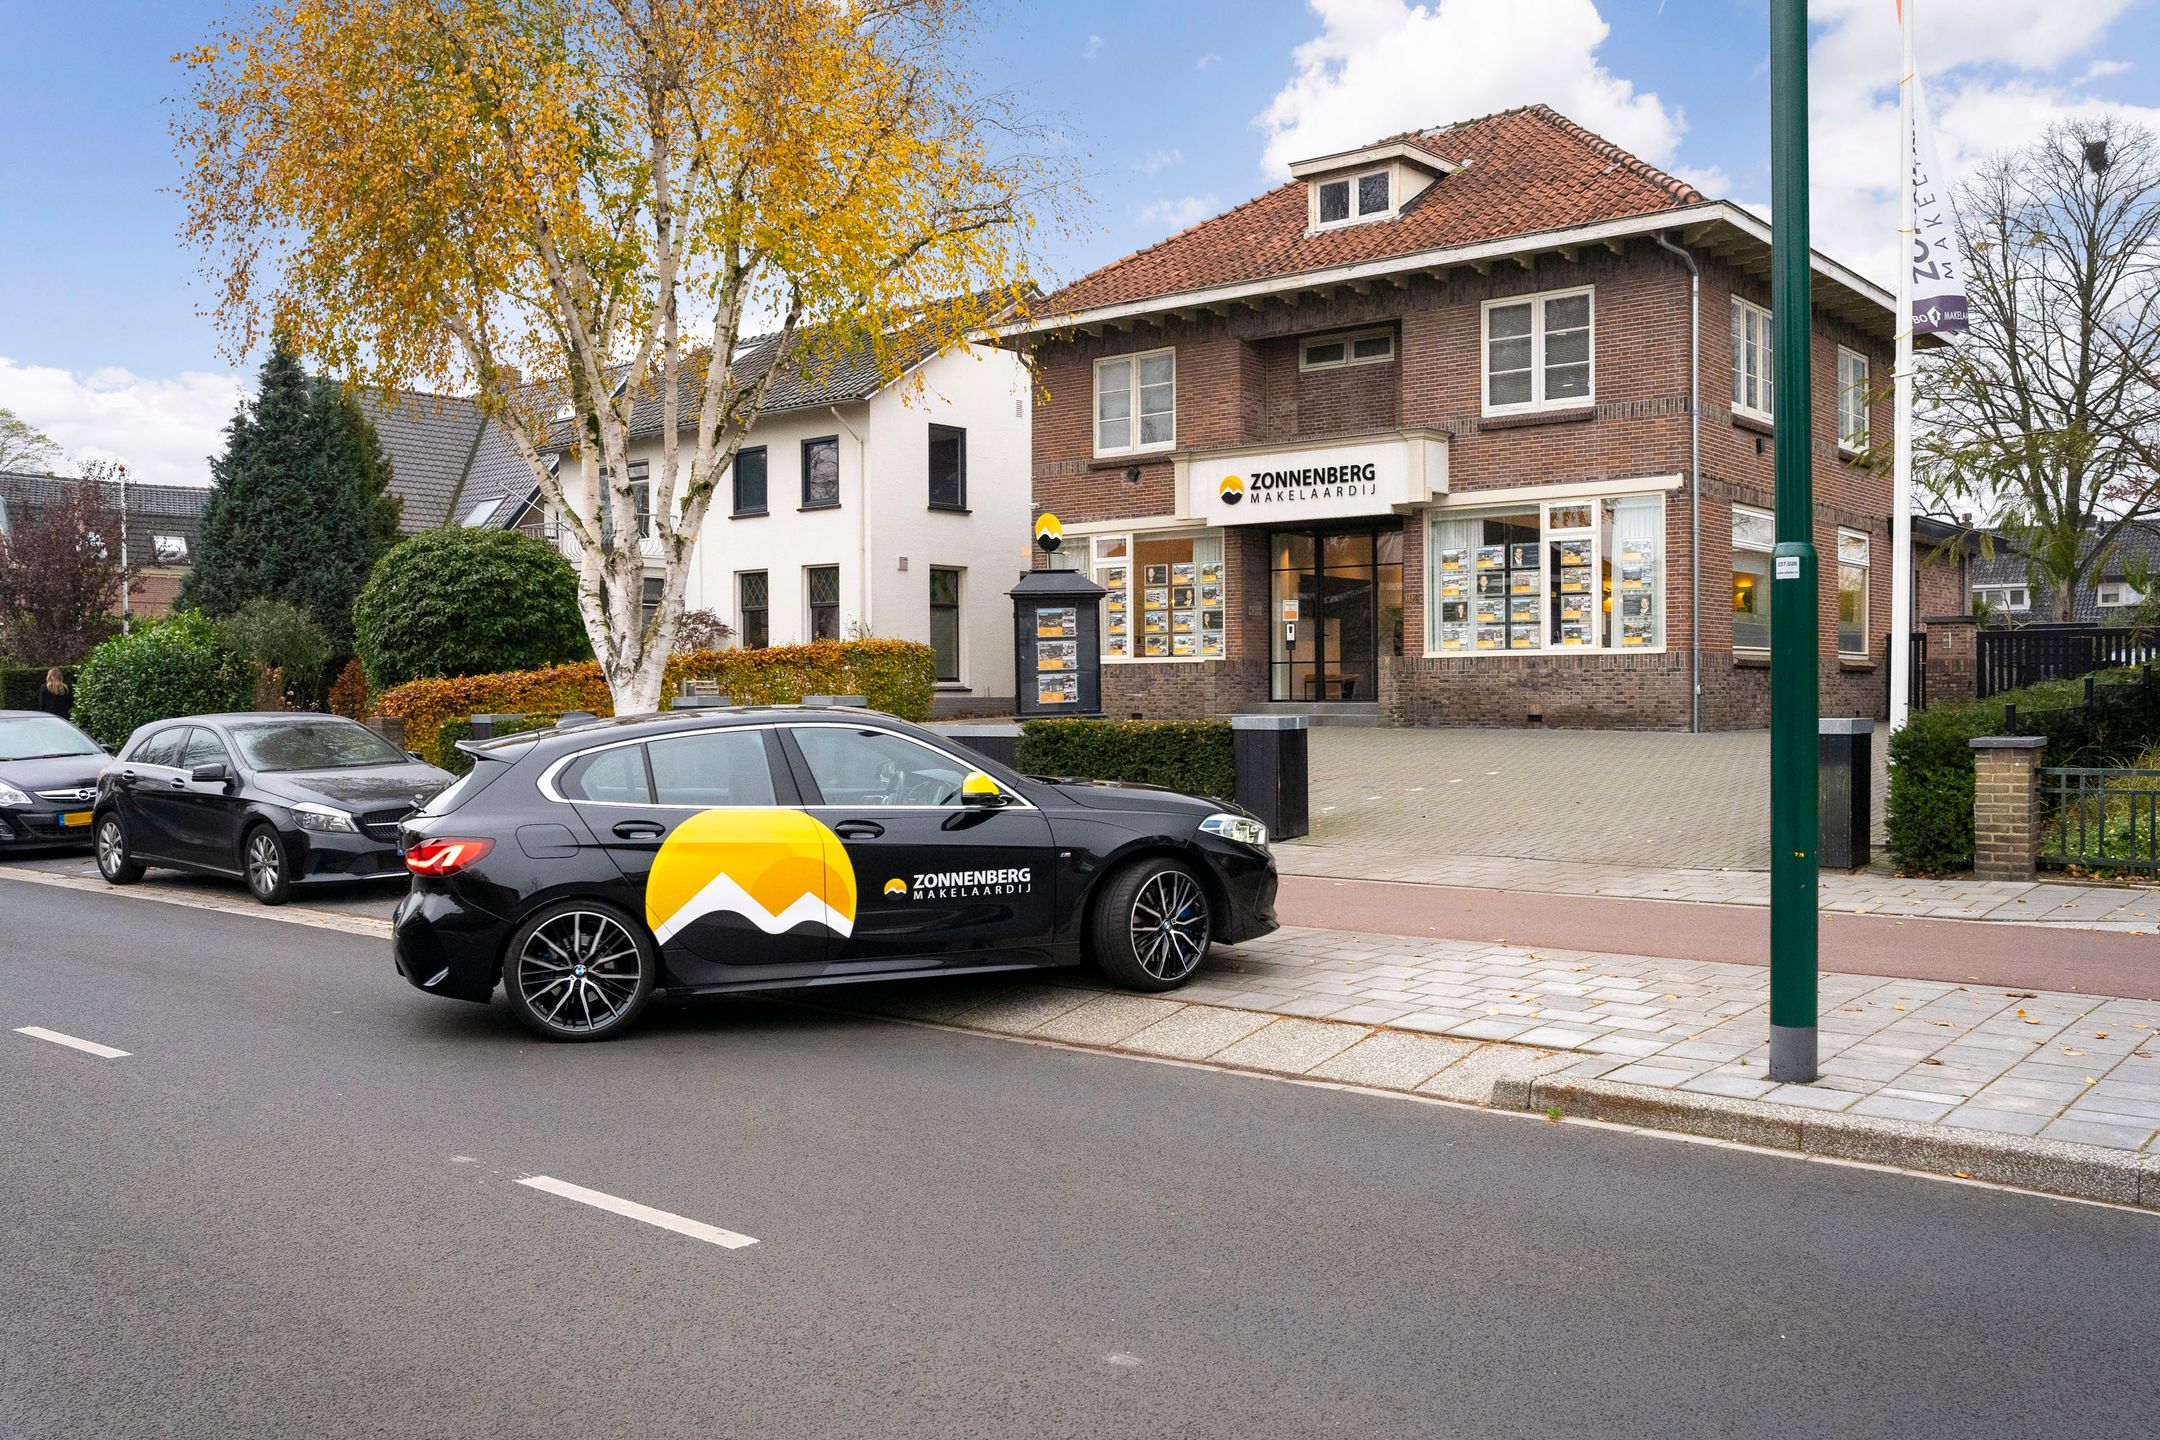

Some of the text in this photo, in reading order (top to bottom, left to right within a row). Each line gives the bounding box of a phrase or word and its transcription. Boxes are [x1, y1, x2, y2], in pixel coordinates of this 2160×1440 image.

[1250, 463, 1376, 491] ZONNENBERG
[1250, 483, 1376, 503] MAKELAARDIJ
[913, 867, 1031, 889] ZONNENBERG
[913, 883, 1031, 900] MAKELAARDIJ
